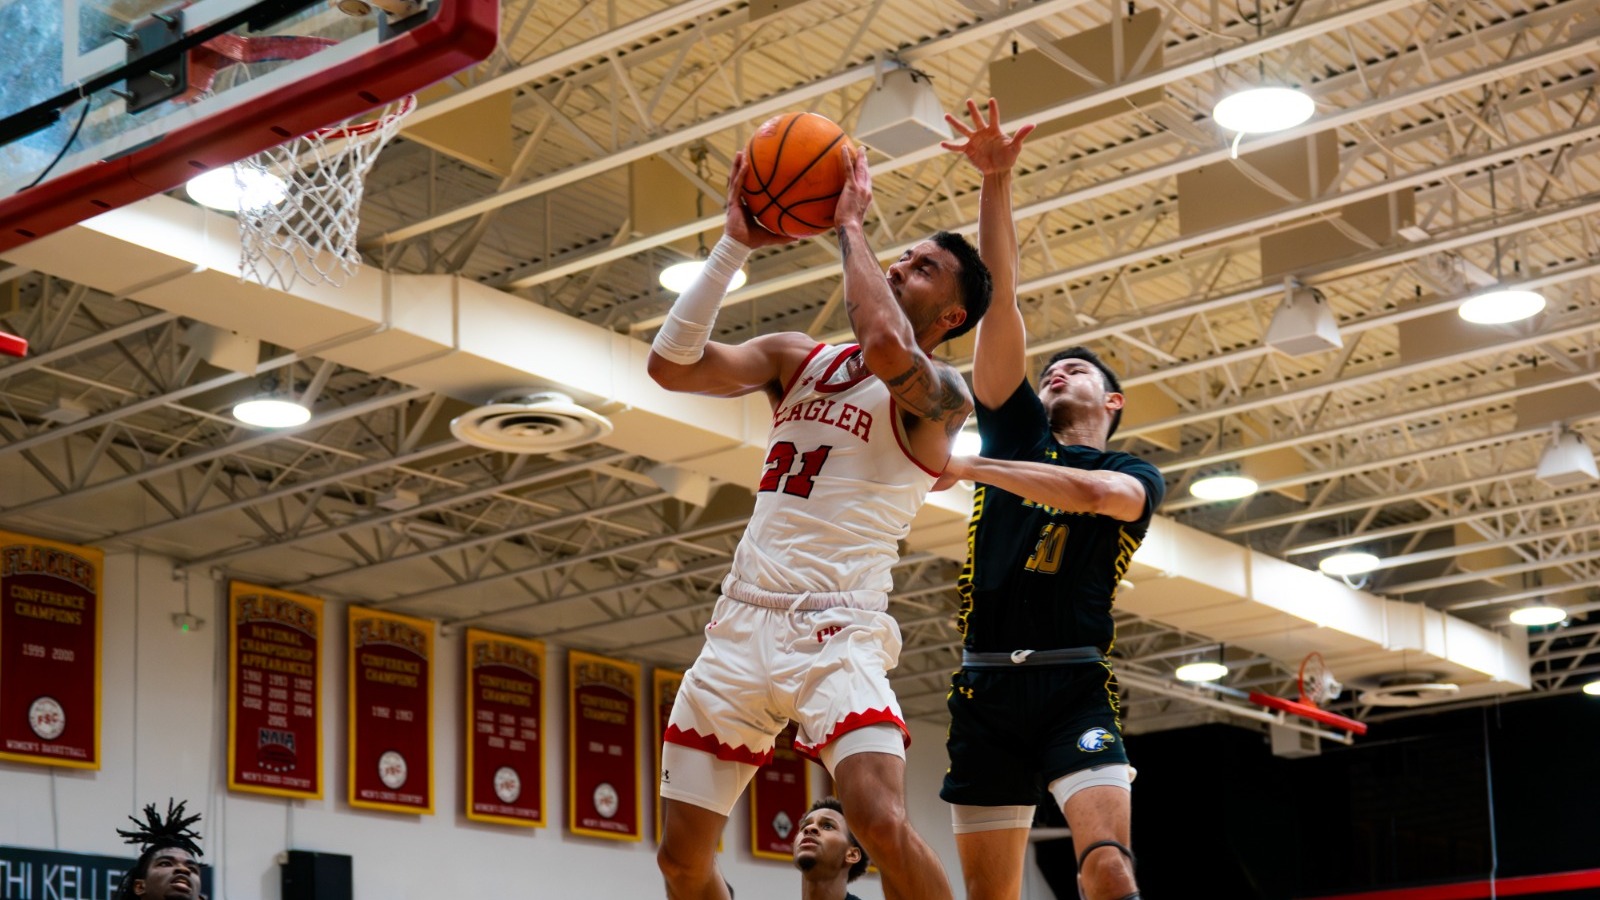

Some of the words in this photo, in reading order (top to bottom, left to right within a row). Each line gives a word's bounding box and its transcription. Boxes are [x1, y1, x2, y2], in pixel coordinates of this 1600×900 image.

[759, 441, 833, 500] 21
[2, 545, 96, 593] FLAGLER
[11, 584, 86, 610] CONFERENCE
[15, 600, 82, 625] CHAMPIONS
[252, 624, 304, 646] NATIONAL
[22, 642, 46, 659] 1999
[51, 647, 75, 662] 2000
[240, 638, 313, 662] CHAMPIONSHIP
[241, 652, 313, 677] APPEARANCES
[360, 653, 420, 675] CONFERENCE
[365, 667, 418, 688] CHAMPIONS
[6, 739, 40, 752] WOMEN'S
[41, 743, 88, 758] BASKETBALL
[258, 728, 296, 753] NAIA
[43, 863, 130, 900] KELLE
